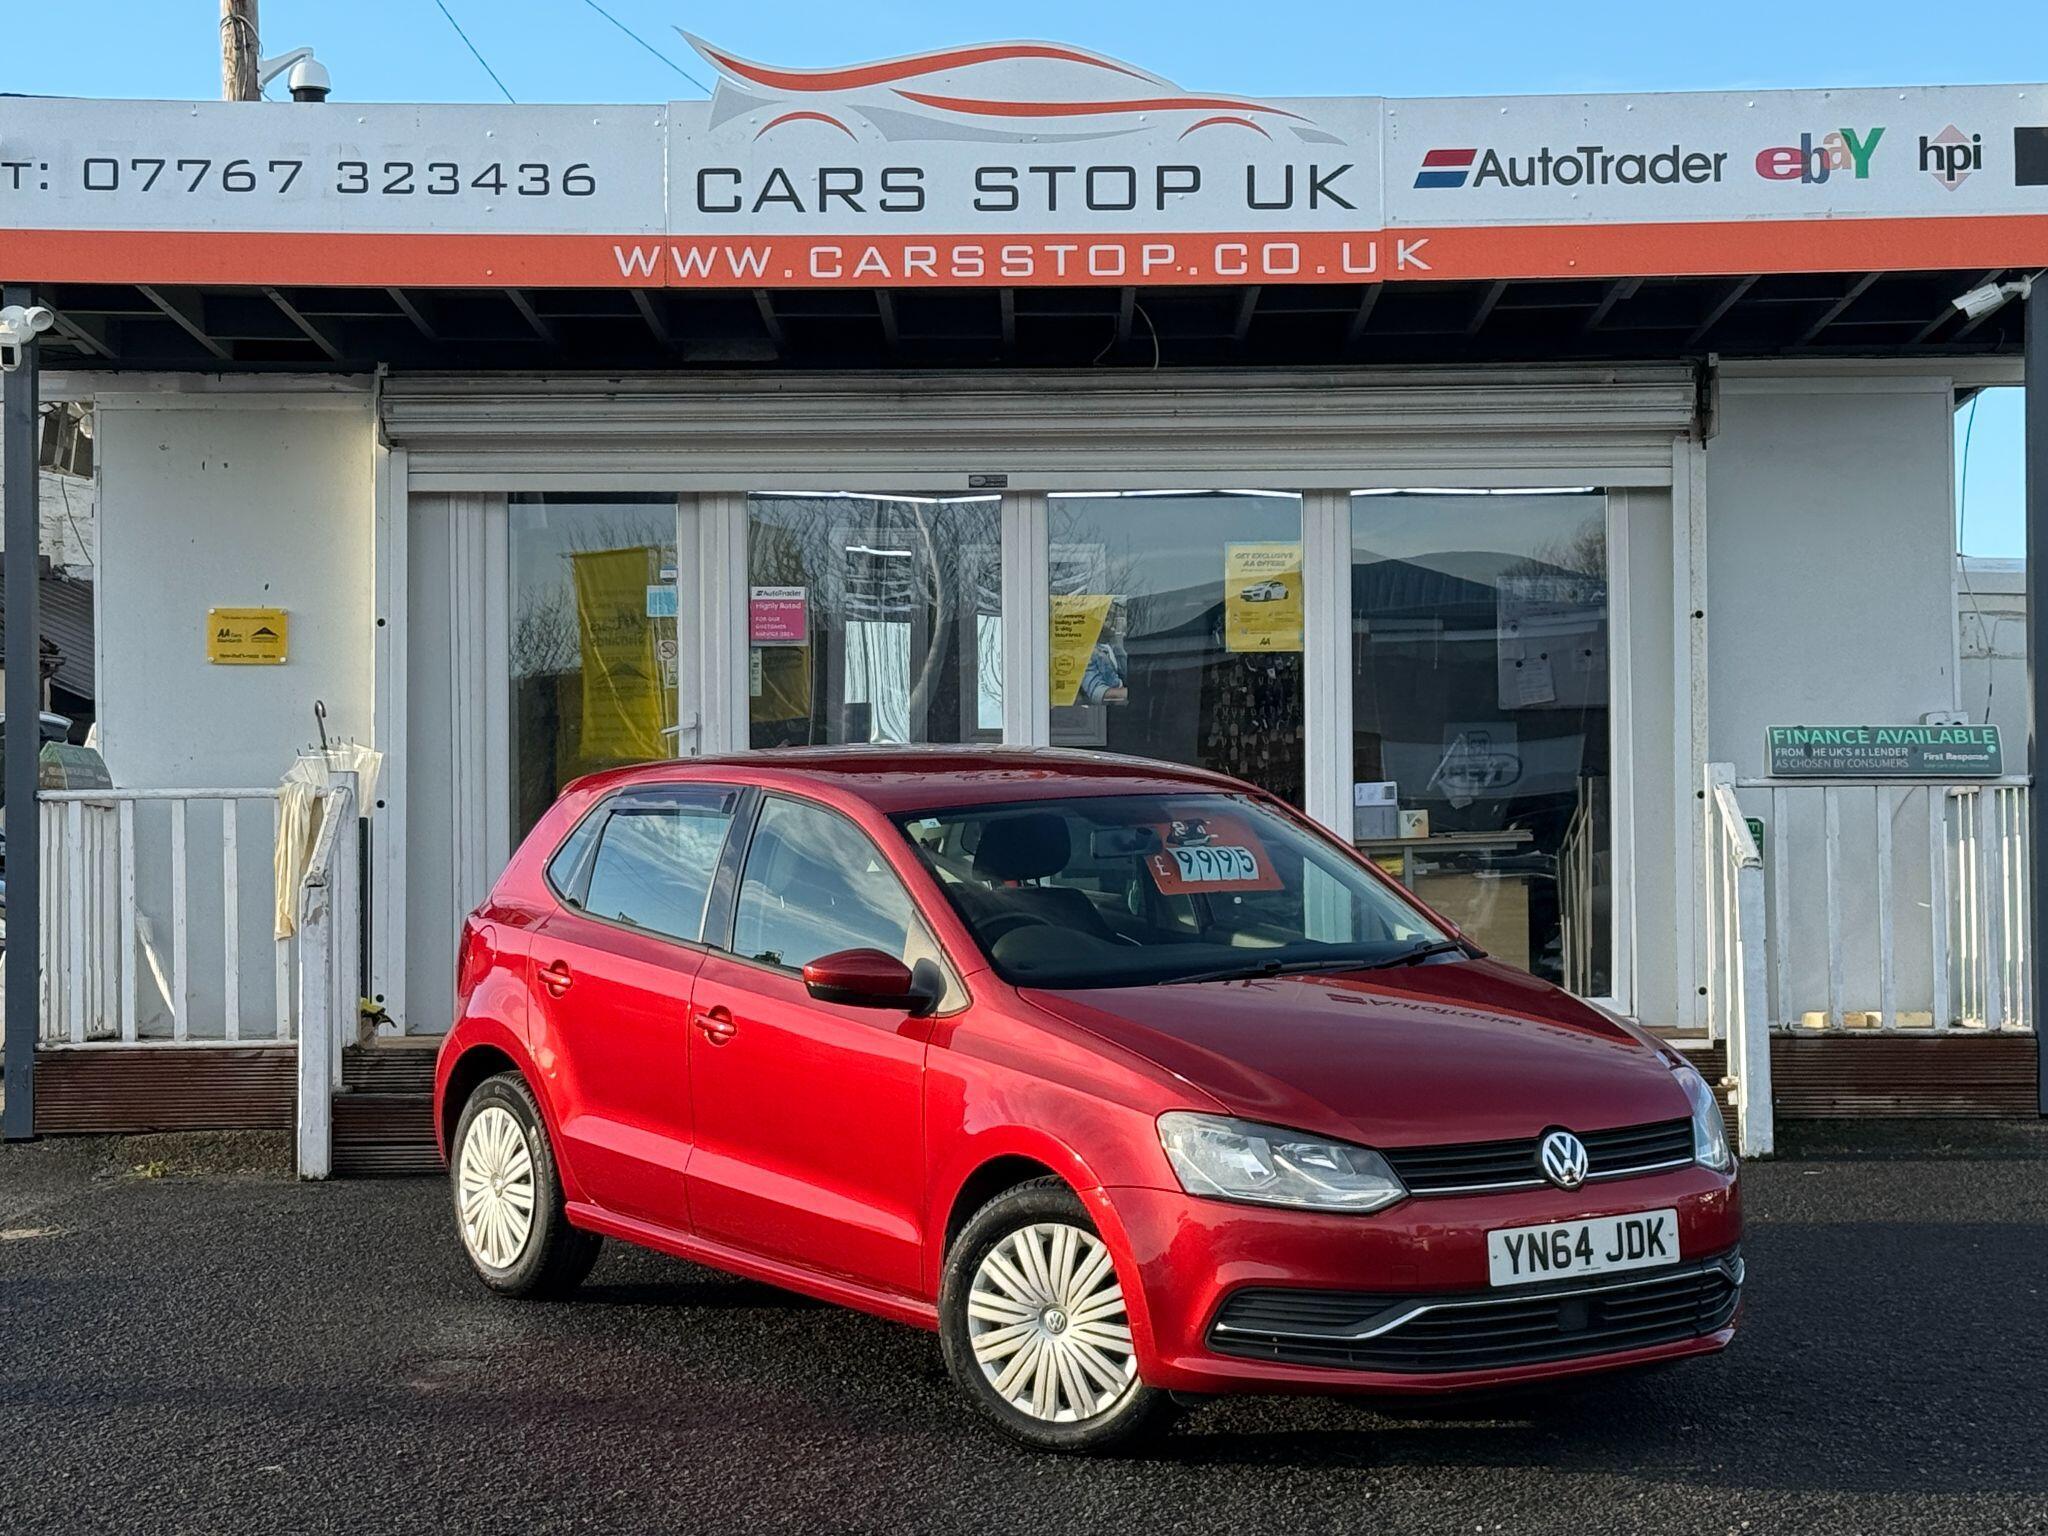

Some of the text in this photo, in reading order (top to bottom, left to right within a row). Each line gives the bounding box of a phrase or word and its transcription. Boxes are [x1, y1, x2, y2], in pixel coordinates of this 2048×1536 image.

[1918, 134, 1982, 182] hpi
[1473, 145, 1728, 188] AutoTrader
[1, 157, 597, 197] T: 07767 323436
[696, 163, 1360, 214] CARS STOP UK
[613, 238, 1433, 280] WWW.CARSSTOP.CO.UK
[763, 589, 801, 597] AutoTrader
[755, 602, 778, 610] Highly
[217, 628, 230, 638] AA
[1260, 637, 1271, 646] AA
[1773, 729, 1996, 745] FINANCE AVAILABLE
[1775, 747, 1804, 757] FROM
[1828, 747, 1853, 757] UK'S
[1854, 748, 1866, 757] #1
[1868, 747, 1909, 757] LENDER
[1923, 752, 1989, 762] First Response
[1776, 759, 1909, 768] AS CHOSEN BY CONSUMERS
[1176, 849, 1254, 875] 9995
[1504, 1216, 1667, 1275] YN64 JDK
